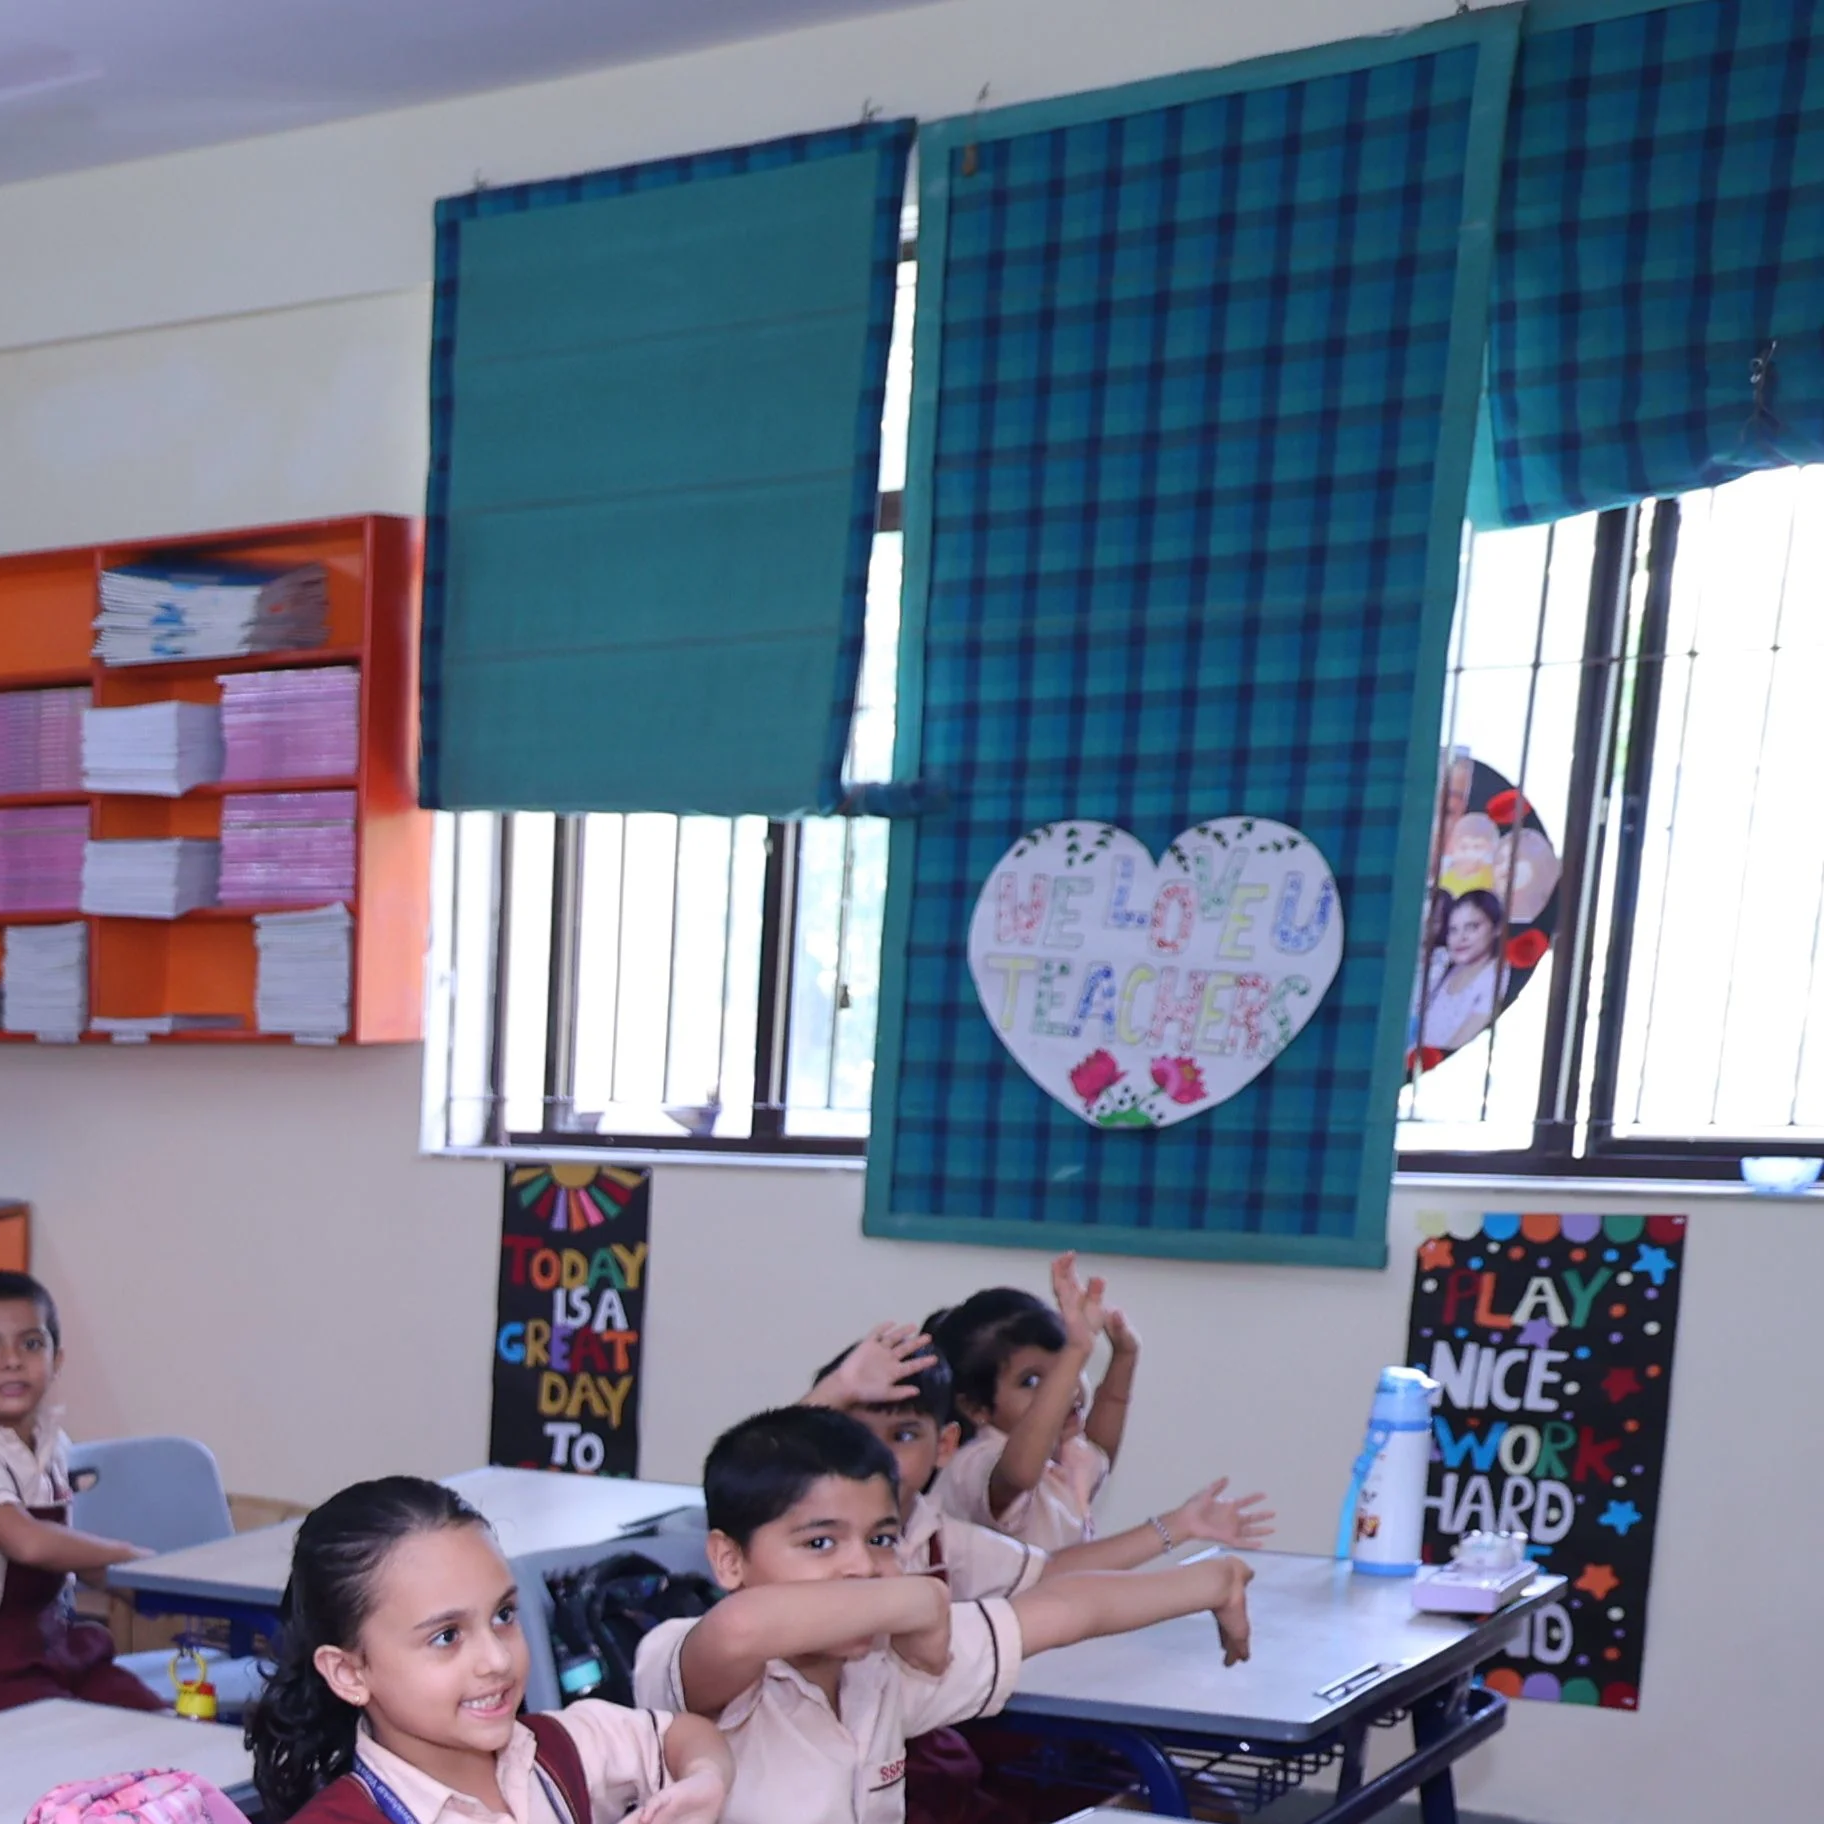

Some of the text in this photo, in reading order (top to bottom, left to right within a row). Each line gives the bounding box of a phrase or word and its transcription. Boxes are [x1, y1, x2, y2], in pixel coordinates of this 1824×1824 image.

[995, 845, 1334, 960] WE LOVE U
[984, 953, 1312, 1061] TEACHERS
[502, 1234, 649, 1290] TODAY
[552, 1285, 629, 1333] IS A
[1443, 1267, 1613, 1329] PLAY
[497, 1318, 638, 1373] GREAT
[537, 1372, 633, 1430] DAY
[1428, 1340, 1570, 1412] NICE
[543, 1421, 604, 1471] TO
[1431, 1414, 1622, 1483] WORK
